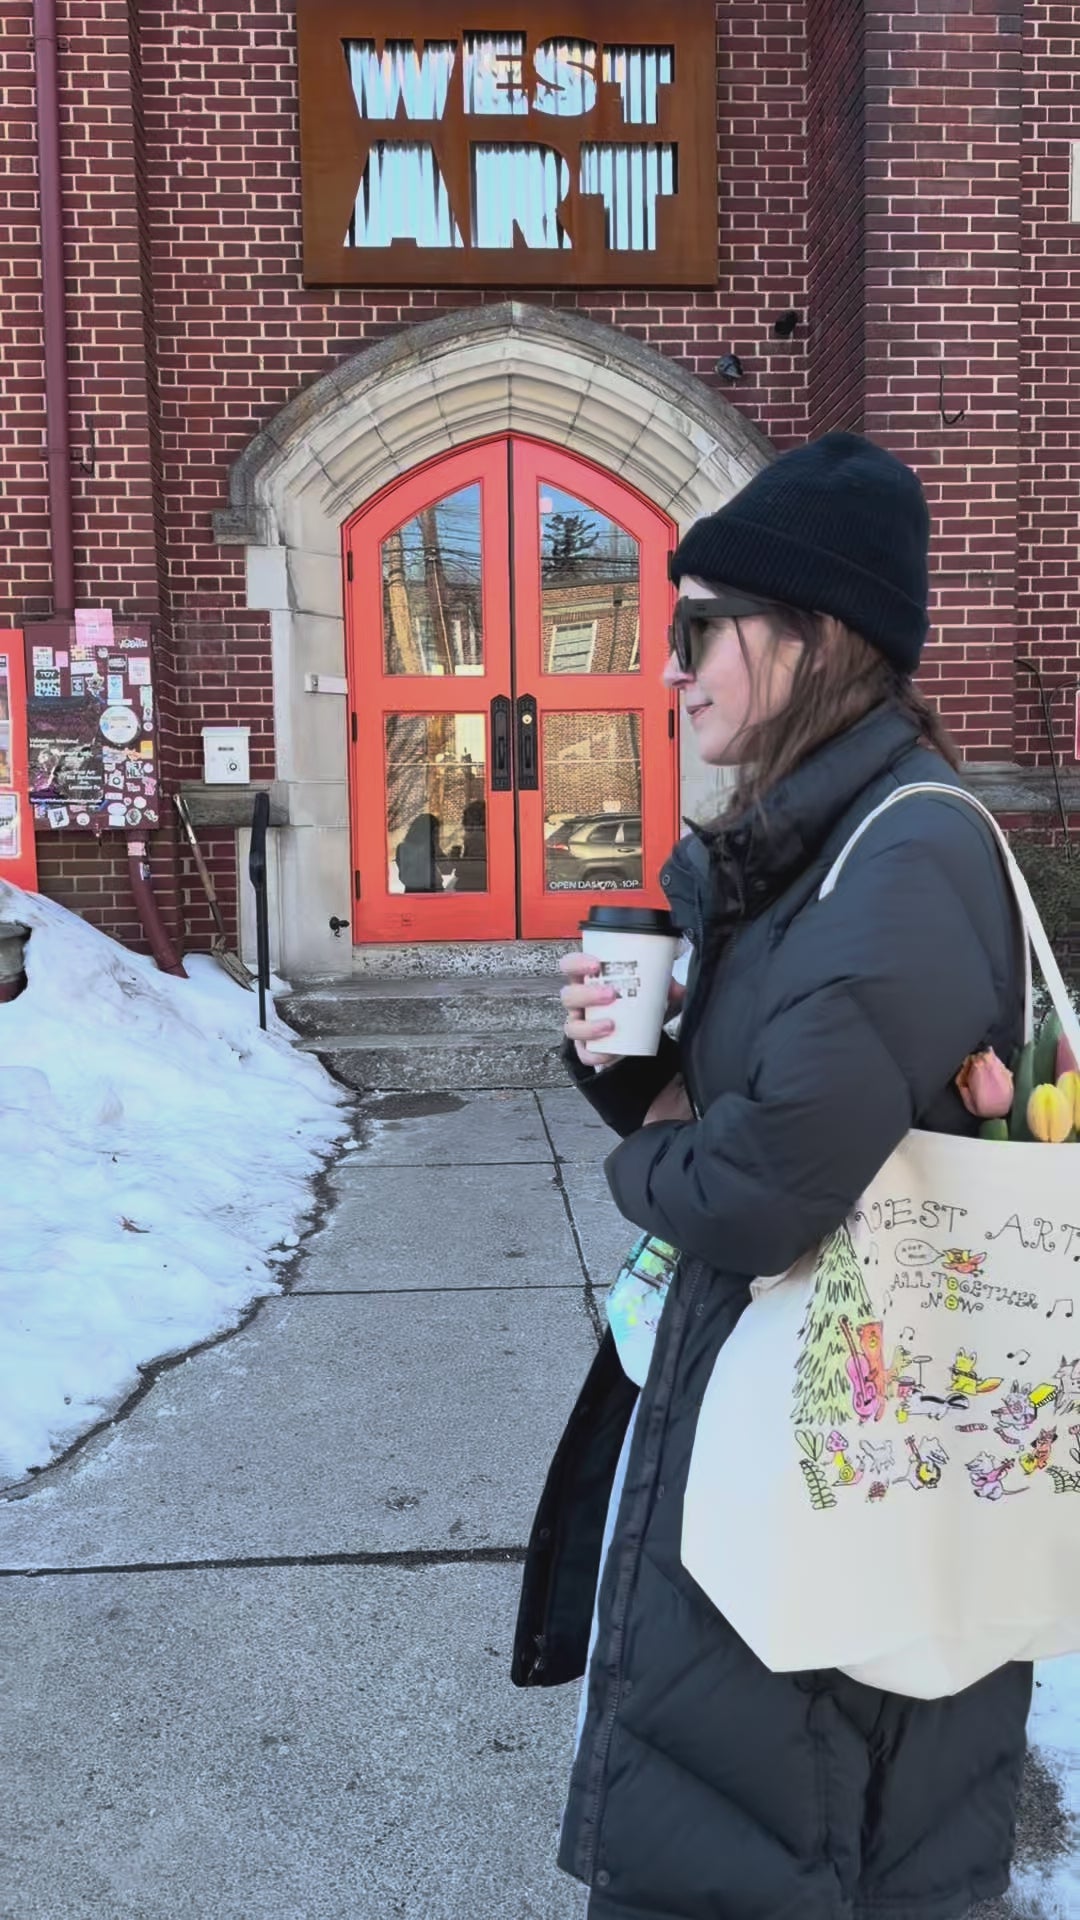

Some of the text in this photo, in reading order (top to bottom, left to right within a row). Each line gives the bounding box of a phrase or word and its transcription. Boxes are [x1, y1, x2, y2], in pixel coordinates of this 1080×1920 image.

[339, 30, 675, 124] WEST
[343, 139, 679, 251] ART
[549, 881, 577, 889] OPEN
[985, 1213, 1080, 1255] ART
[890, 1271, 931, 1291] ALL
[920, 1292, 984, 1314] NOW
